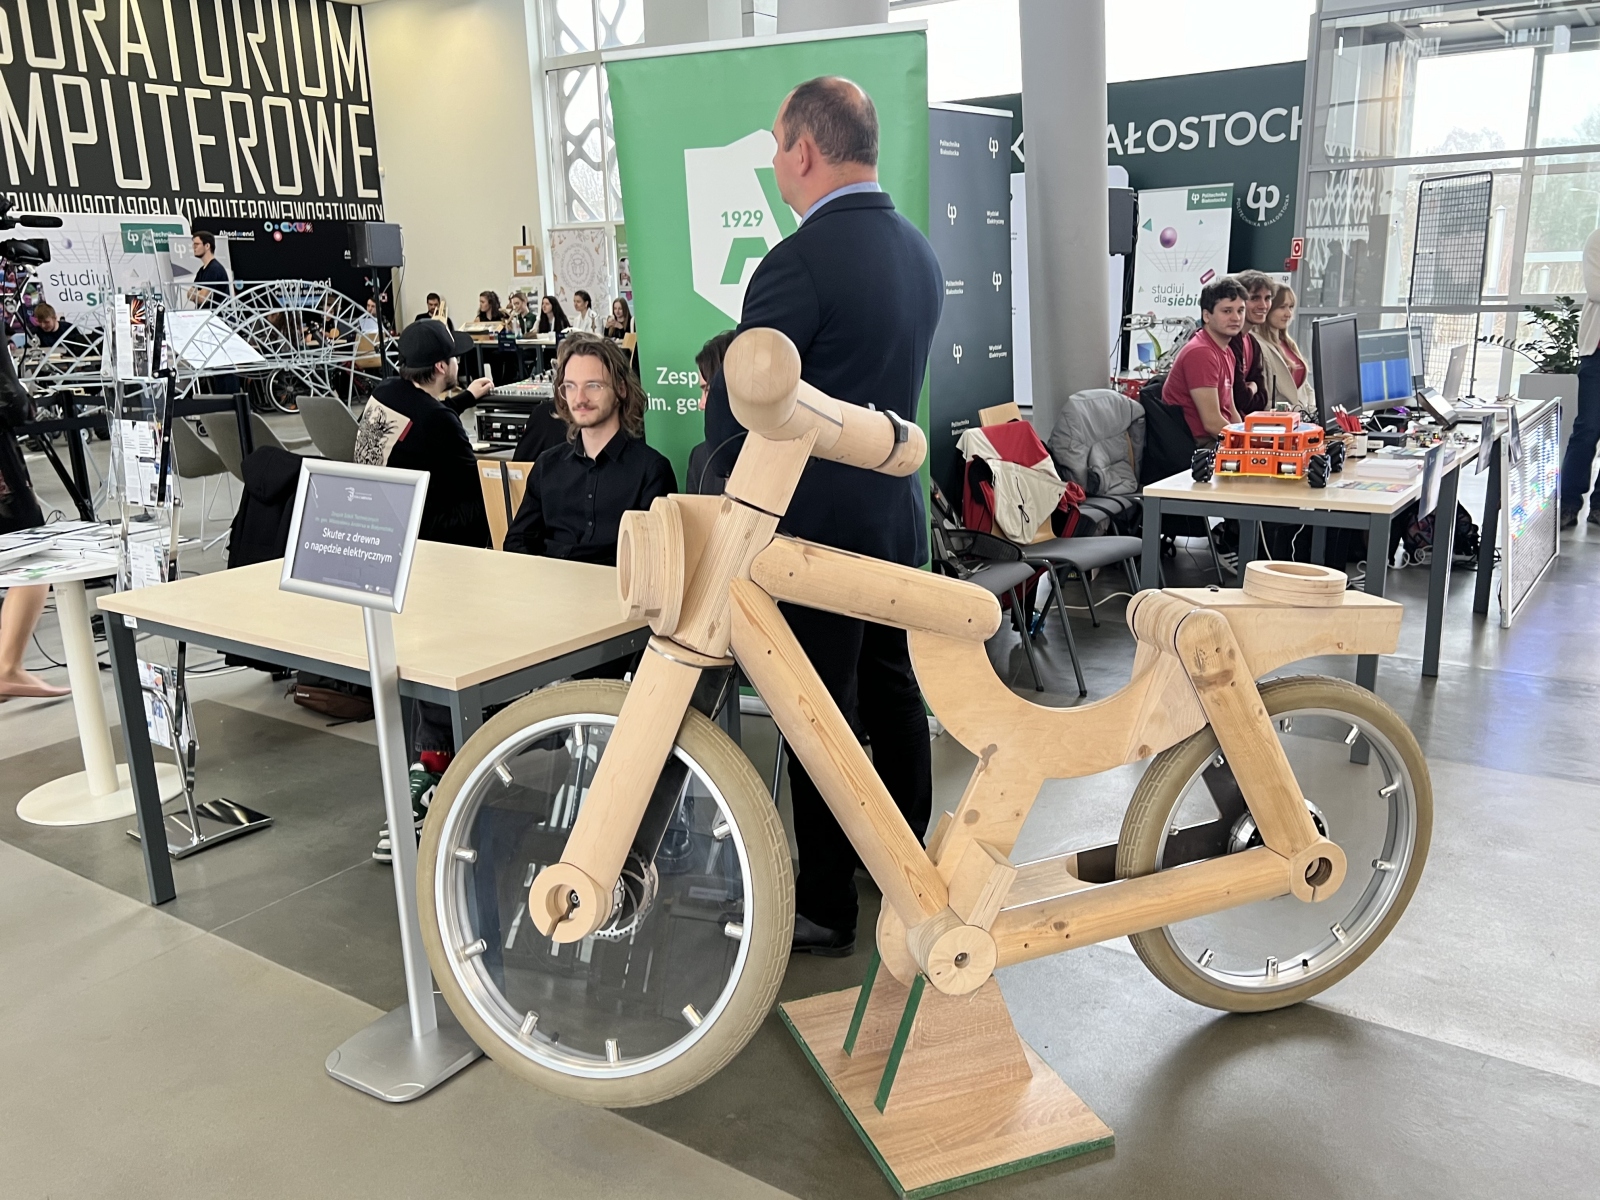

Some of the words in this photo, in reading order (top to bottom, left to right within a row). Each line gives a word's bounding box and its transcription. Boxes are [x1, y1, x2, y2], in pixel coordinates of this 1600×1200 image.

[720, 209, 764, 228] 1929
[1236, 197, 1261, 227] POLITECHNIKA
[1263, 194, 1290, 227] BIAŁOSTOCKA
[50, 269, 111, 290] studiuj
[59, 288, 83, 302] dla
[1151, 283, 1185, 297] studiuj
[1154, 295, 1167, 304] dla
[656, 366, 699, 388] Zesp
[647, 392, 671, 411] im.
[322, 527, 344, 540] Skuter
[346, 533, 351, 541] z
[352, 532, 380, 545] drewna
[304, 541, 309, 549] o
[310, 541, 342, 555] napędzie
[343, 546, 392, 563] elektrycznym
